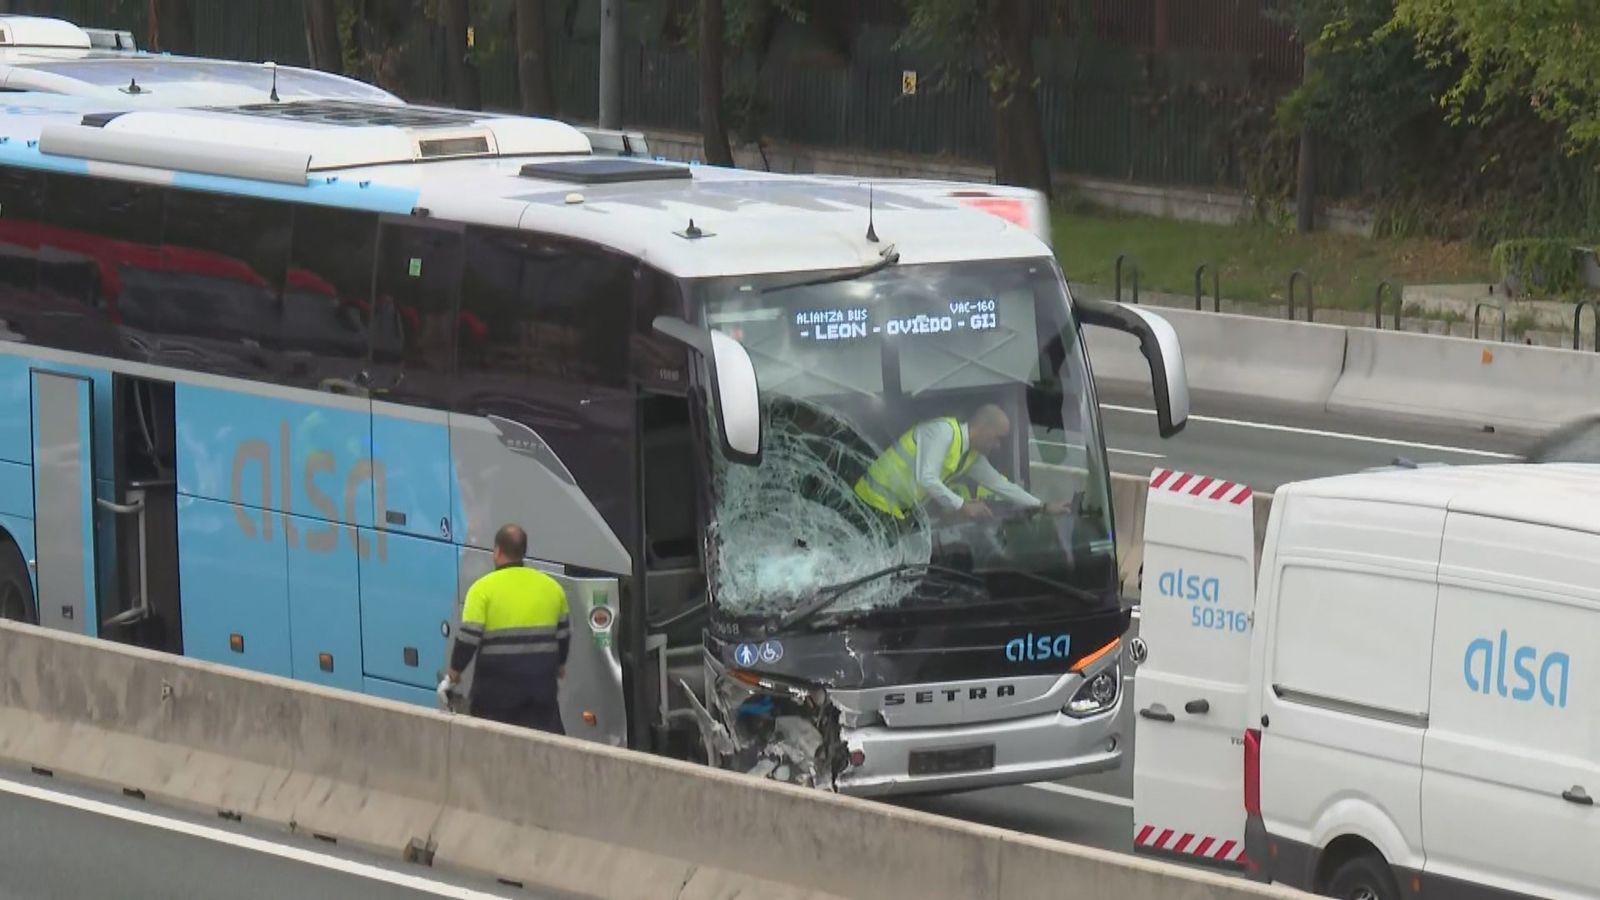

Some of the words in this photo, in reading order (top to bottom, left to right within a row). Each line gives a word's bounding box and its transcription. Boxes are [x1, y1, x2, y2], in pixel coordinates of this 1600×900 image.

[797, 310, 843, 325] ALIANZA
[847, 308, 868, 322] BUS
[950, 300, 995, 315] VAC-160
[815, 323, 867, 340] LEON
[887, 316, 952, 336] OVIEDO
[230, 417, 388, 563] alsa
[1158, 567, 1220, 603] alsa
[1191, 605, 1248, 633] 50316
[1006, 632, 1071, 662] alsa
[1463, 628, 1570, 708] alsa
[884, 684, 1016, 706] SETRA
